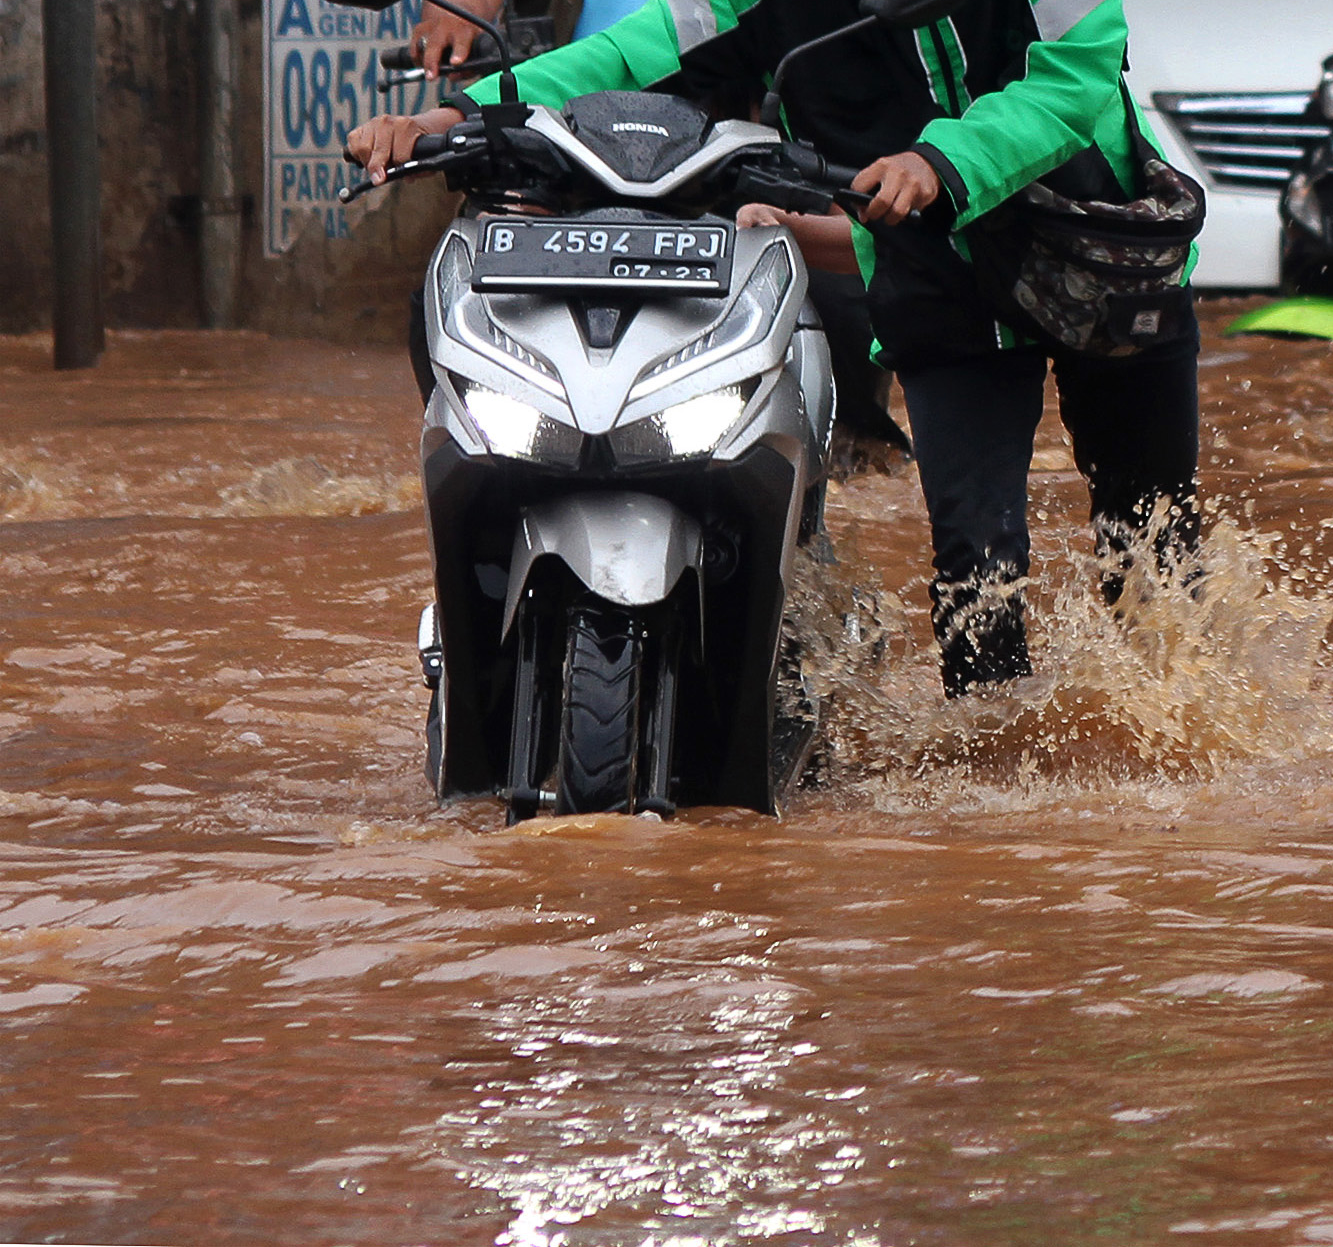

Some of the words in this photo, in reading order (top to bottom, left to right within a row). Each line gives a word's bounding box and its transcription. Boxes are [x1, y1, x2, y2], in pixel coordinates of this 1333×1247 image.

[612, 122, 669, 137] HONDA
[494, 228, 515, 253] B
[543, 230, 631, 254] 4594
[653, 232, 719, 258] FPJ
